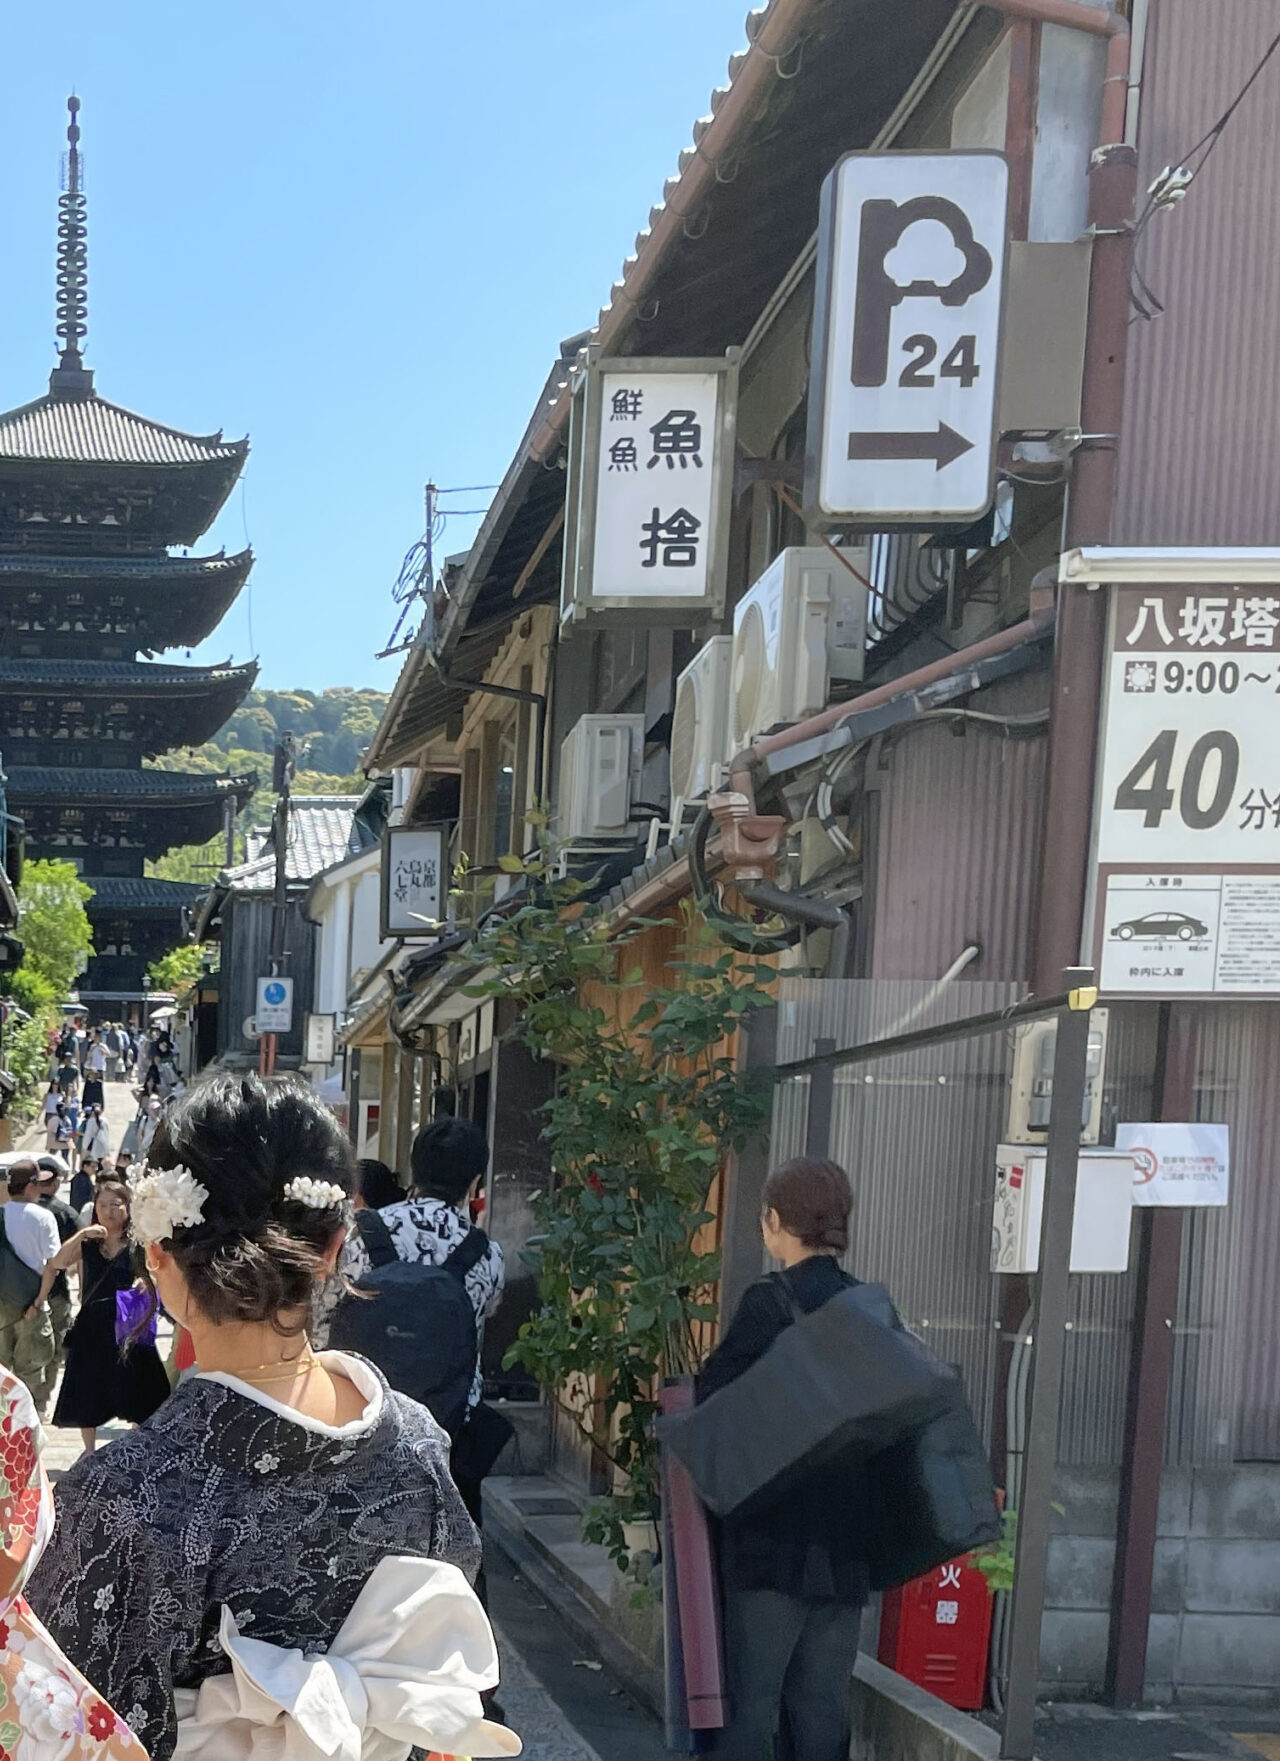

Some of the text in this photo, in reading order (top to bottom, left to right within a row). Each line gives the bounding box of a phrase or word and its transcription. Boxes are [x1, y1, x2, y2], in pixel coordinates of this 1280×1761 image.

[899, 334, 980, 388] 24
[608, 388, 644, 473] 鮮魚
[1125, 596, 1280, 647] 八坂塔
[1163, 660, 1280, 695] 9:00～
